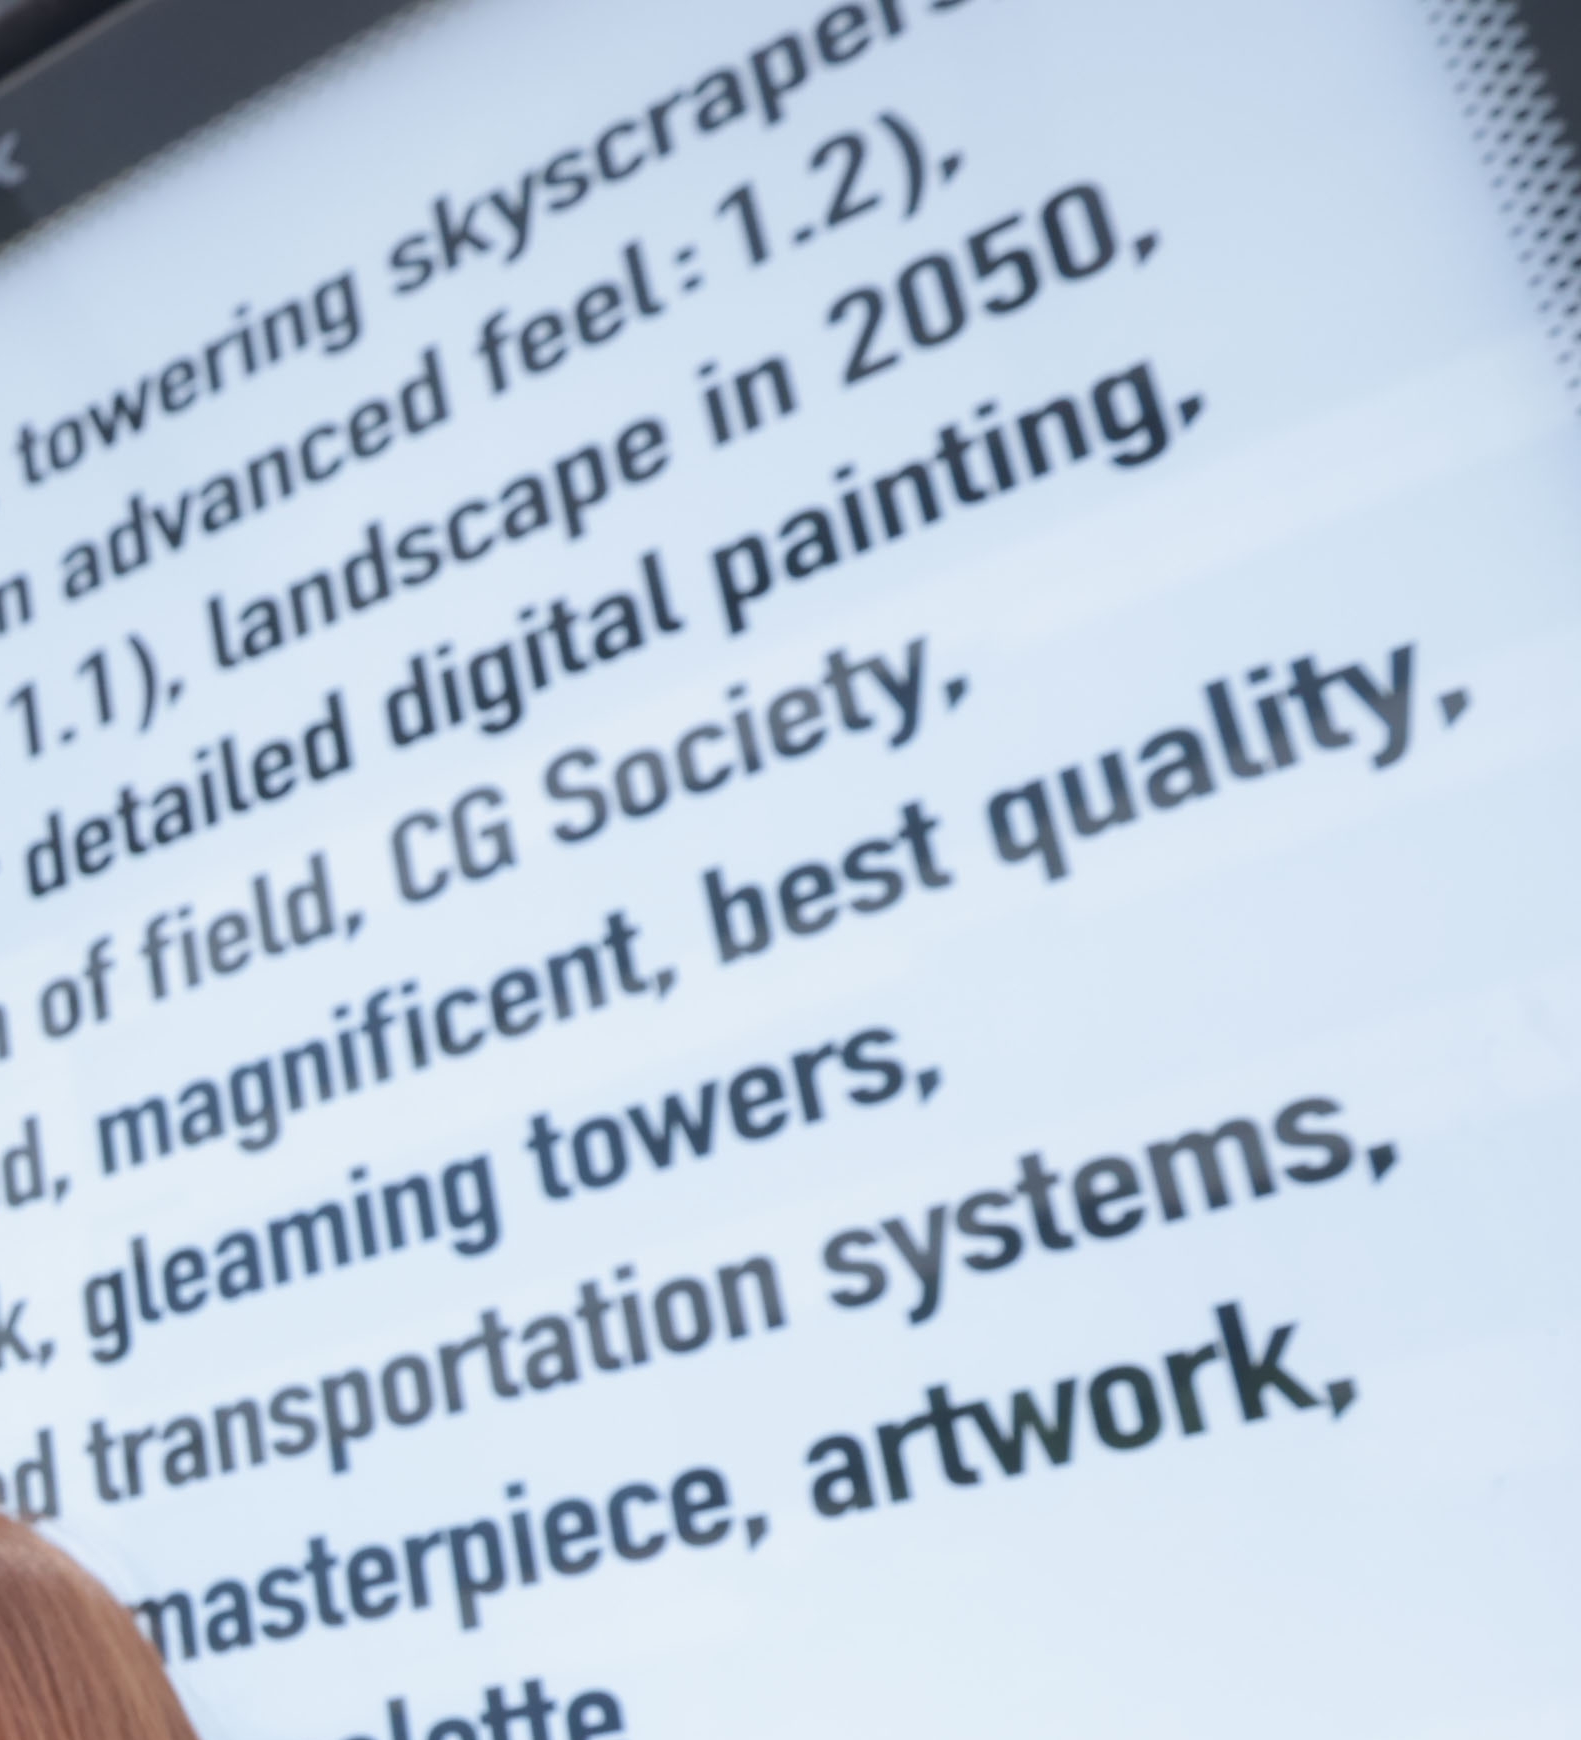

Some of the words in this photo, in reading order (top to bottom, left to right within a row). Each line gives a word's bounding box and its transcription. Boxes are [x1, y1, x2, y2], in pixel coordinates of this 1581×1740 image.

[15, 268, 361, 485] towering
[60, 344, 450, 600] advanced
[207, 413, 669, 670] landscape
[697, 354, 798, 450] in
[826, 181, 1159, 388] 2050,
[24, 690, 351, 897] detailed
[385, 546, 683, 747] digital
[709, 356, 1205, 635] painting,
[39, 934, 113, 1042] of
[138, 850, 365, 1004] field,
[389, 785, 518, 906] CG
[541, 635, 971, 847] Society,
[94, 907, 680, 1177] magnificent,
[702, 798, 952, 967] best
[983, 642, 1473, 885] quality,
[83, 1149, 504, 1364] gleaming
[525, 1027, 945, 1202] towers,
[83, 1253, 788, 1506] transportation
[821, 1094, 1400, 1325] systems,
[128, 1464, 769, 1662] masterpiece,
[805, 1300, 1359, 1518] artwork,
